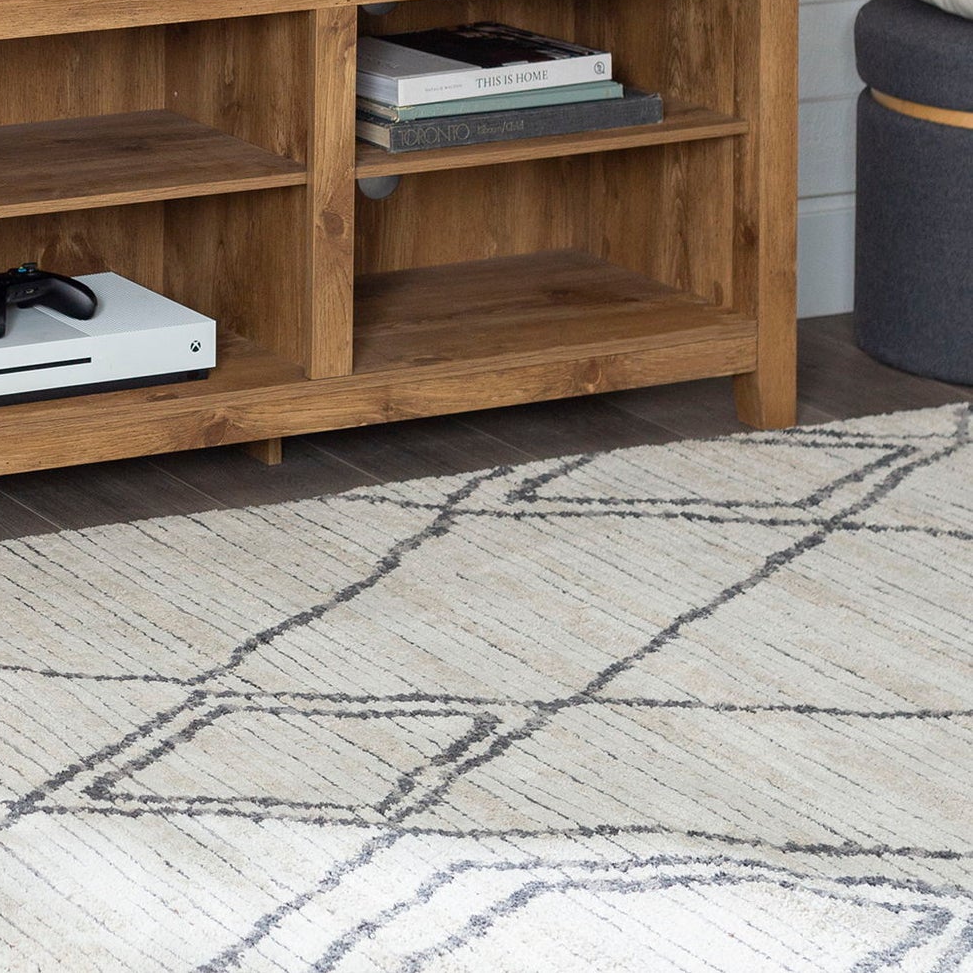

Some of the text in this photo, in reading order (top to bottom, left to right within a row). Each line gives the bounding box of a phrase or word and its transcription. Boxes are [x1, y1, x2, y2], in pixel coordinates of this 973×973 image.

[476, 70, 549, 89] THIS IS HOME
[398, 123, 471, 147] TORONTO
